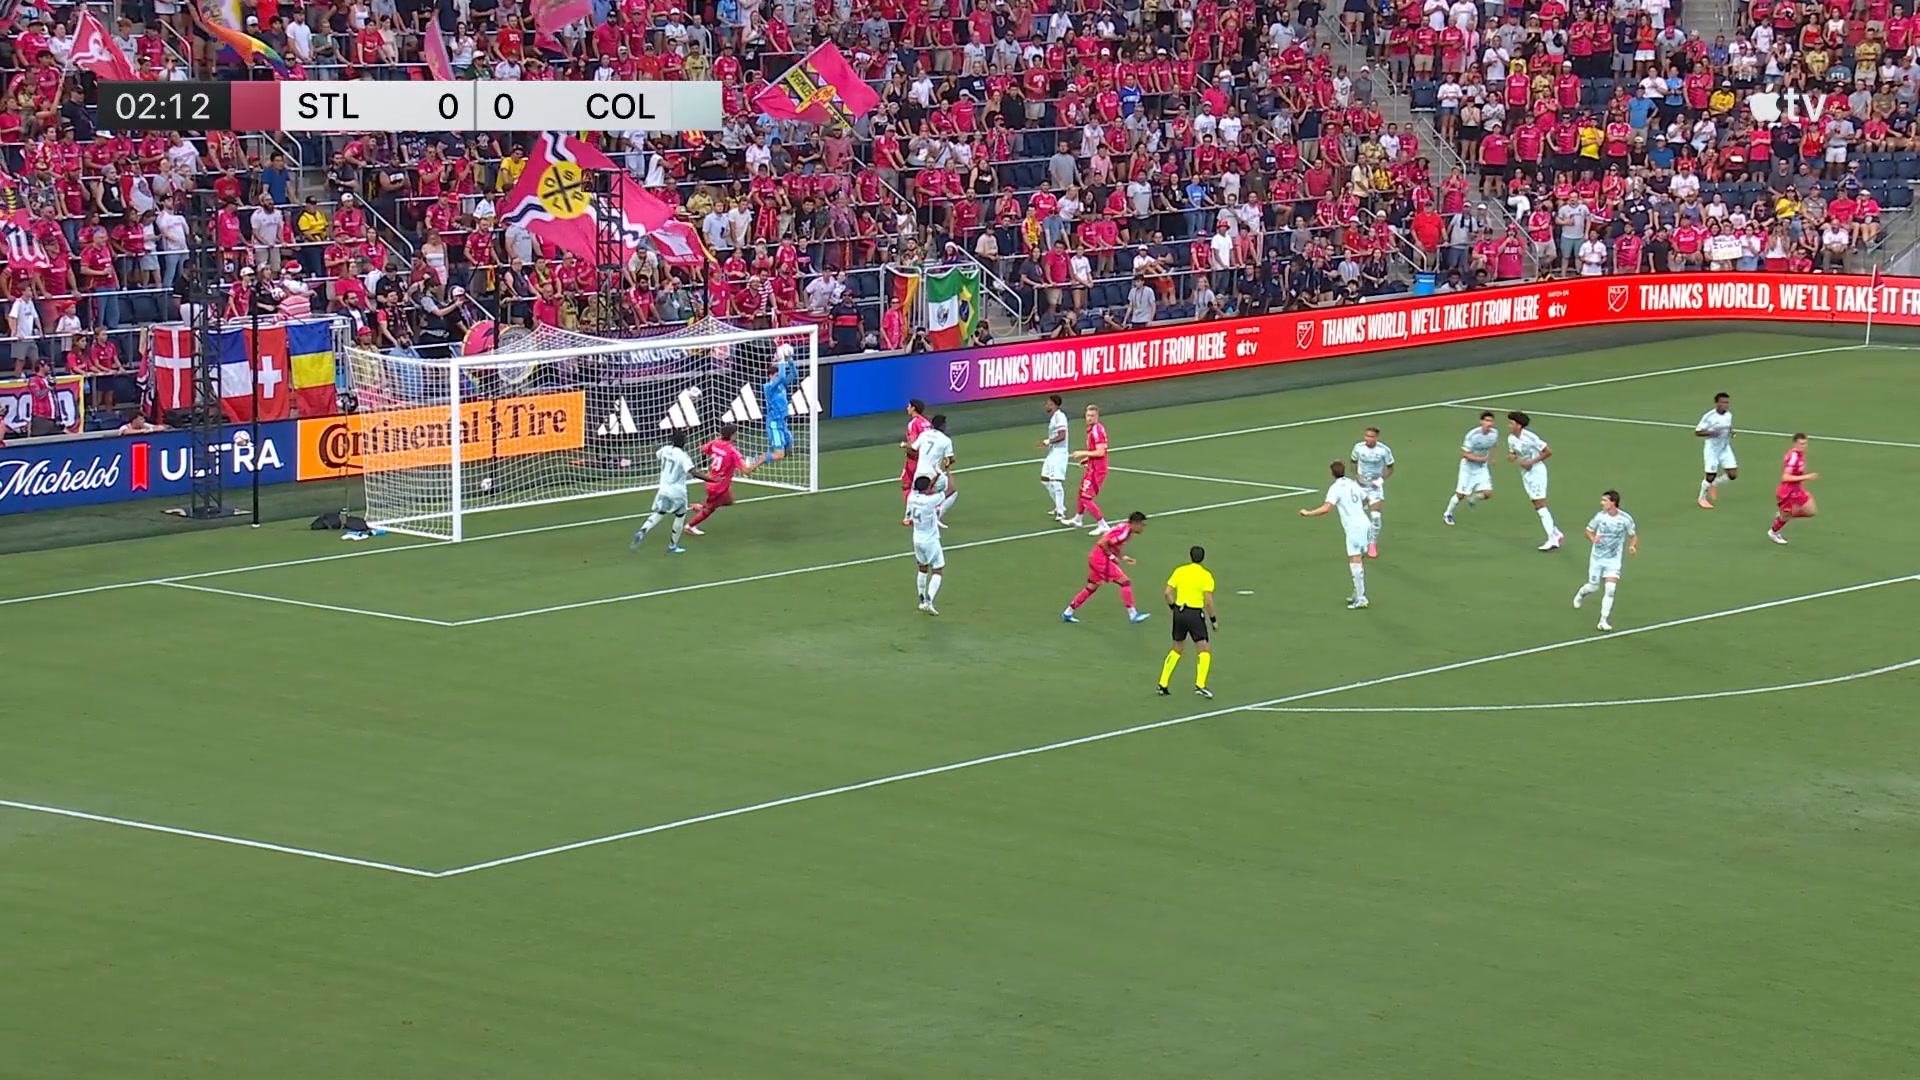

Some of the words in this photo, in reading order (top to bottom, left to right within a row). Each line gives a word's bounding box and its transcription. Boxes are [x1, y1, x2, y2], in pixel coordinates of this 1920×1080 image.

[1555, 303, 1567, 317] tv
[1639, 282, 1703, 311] THANKS
[1707, 282, 1775, 313] WORLD,
[1779, 284, 1832, 311] WE'LL
[1834, 285, 1878, 313] TAKE
[1881, 287, 1900, 314] IT
[1321, 315, 1366, 346] THANKS
[1368, 311, 1408, 341] WORLD,
[1411, 306, 1441, 336] WE'LL
[1443, 303, 1470, 331] TAKE
[1470, 301, 1482, 328] IT
[1482, 298, 1512, 326] FROM
[1513, 294, 1540, 322] HERE
[978, 354, 1029, 388] THANKS
[1032, 350, 1079, 381] WORLD,
[1081, 345, 1116, 376] WE'LL
[1118, 341, 1147, 371] TAKE
[1149, 340, 1162, 367] IT
[1162, 335, 1195, 366] FROM
[1197, 331, 1227, 361] HERE
[1246, 340, 1258, 355] tv
[504, 403, 567, 439] Tire
[926, 441, 935, 455] 7
[0, 456, 121, 500] Michelob
[1351, 489, 1359, 503] 6
